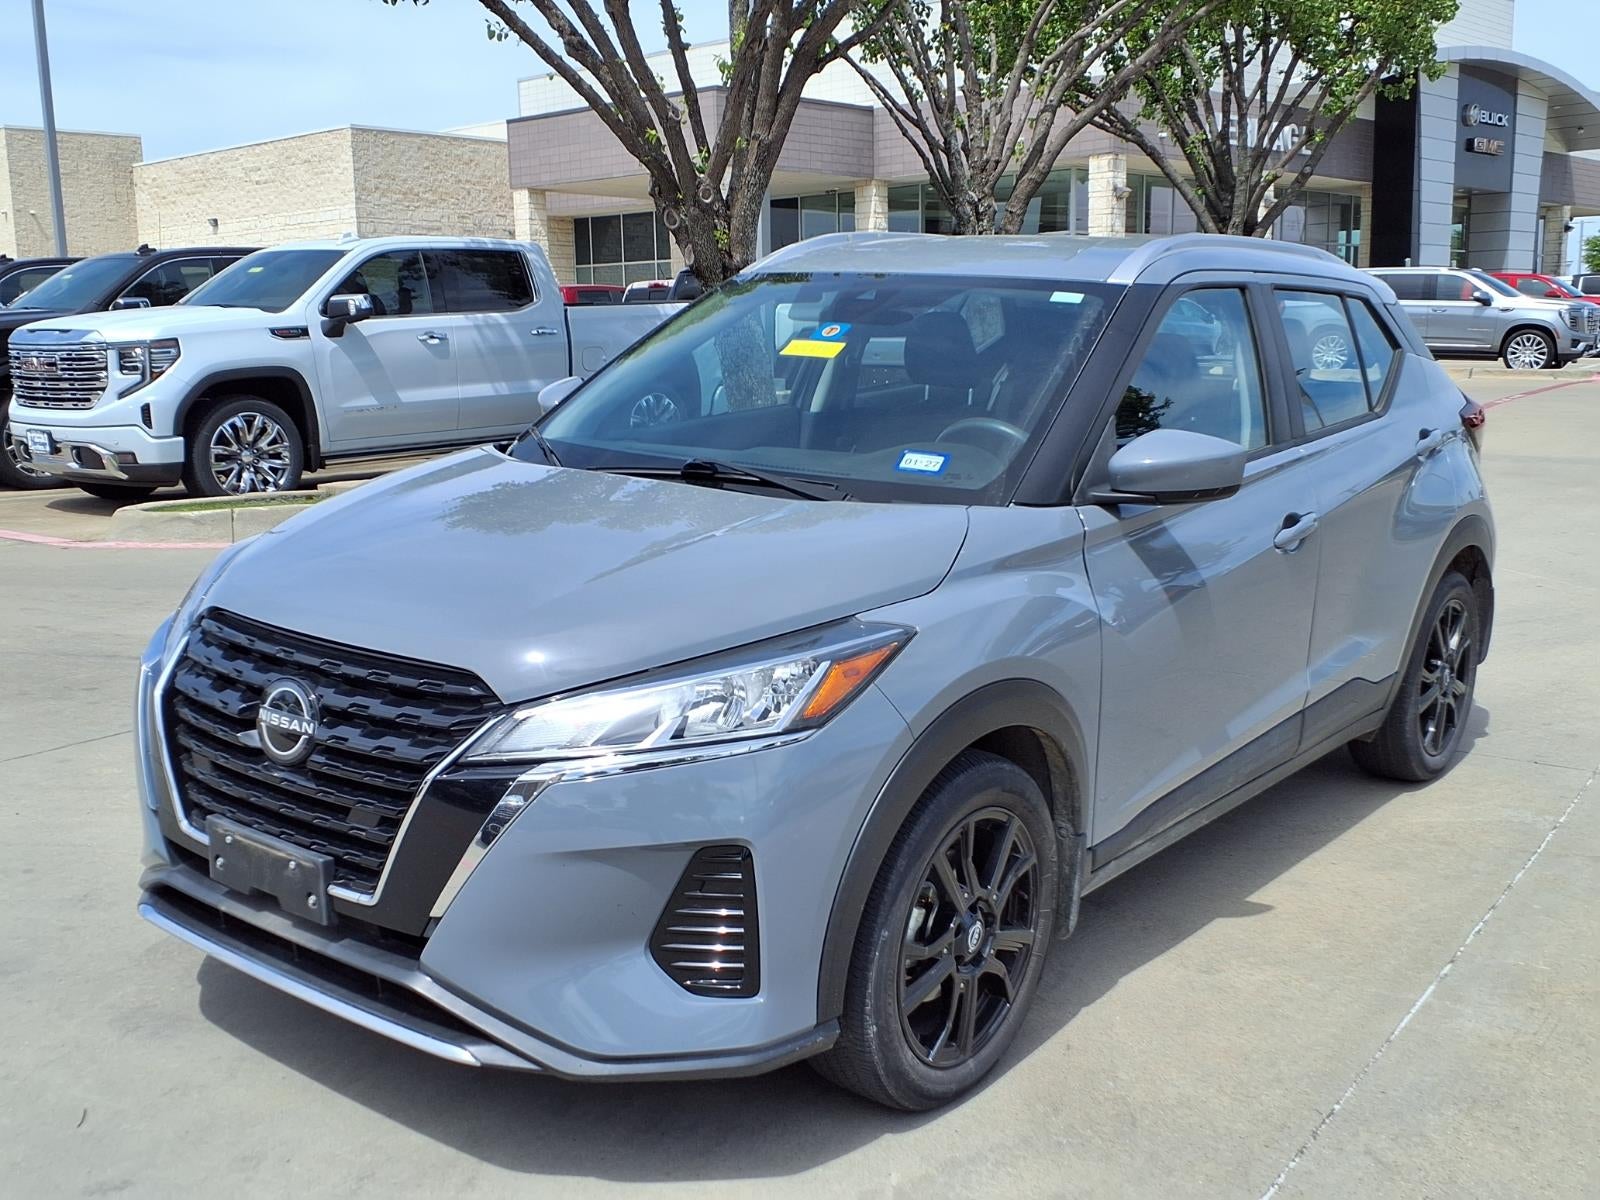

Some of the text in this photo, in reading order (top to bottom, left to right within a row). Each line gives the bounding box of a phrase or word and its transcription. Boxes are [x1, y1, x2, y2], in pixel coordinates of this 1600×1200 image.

[1480, 110, 1509, 127] BUICK
[1474, 137, 1504, 155] GMC
[20, 357, 57, 372] GMC
[259, 706, 314, 734] NISSAN
